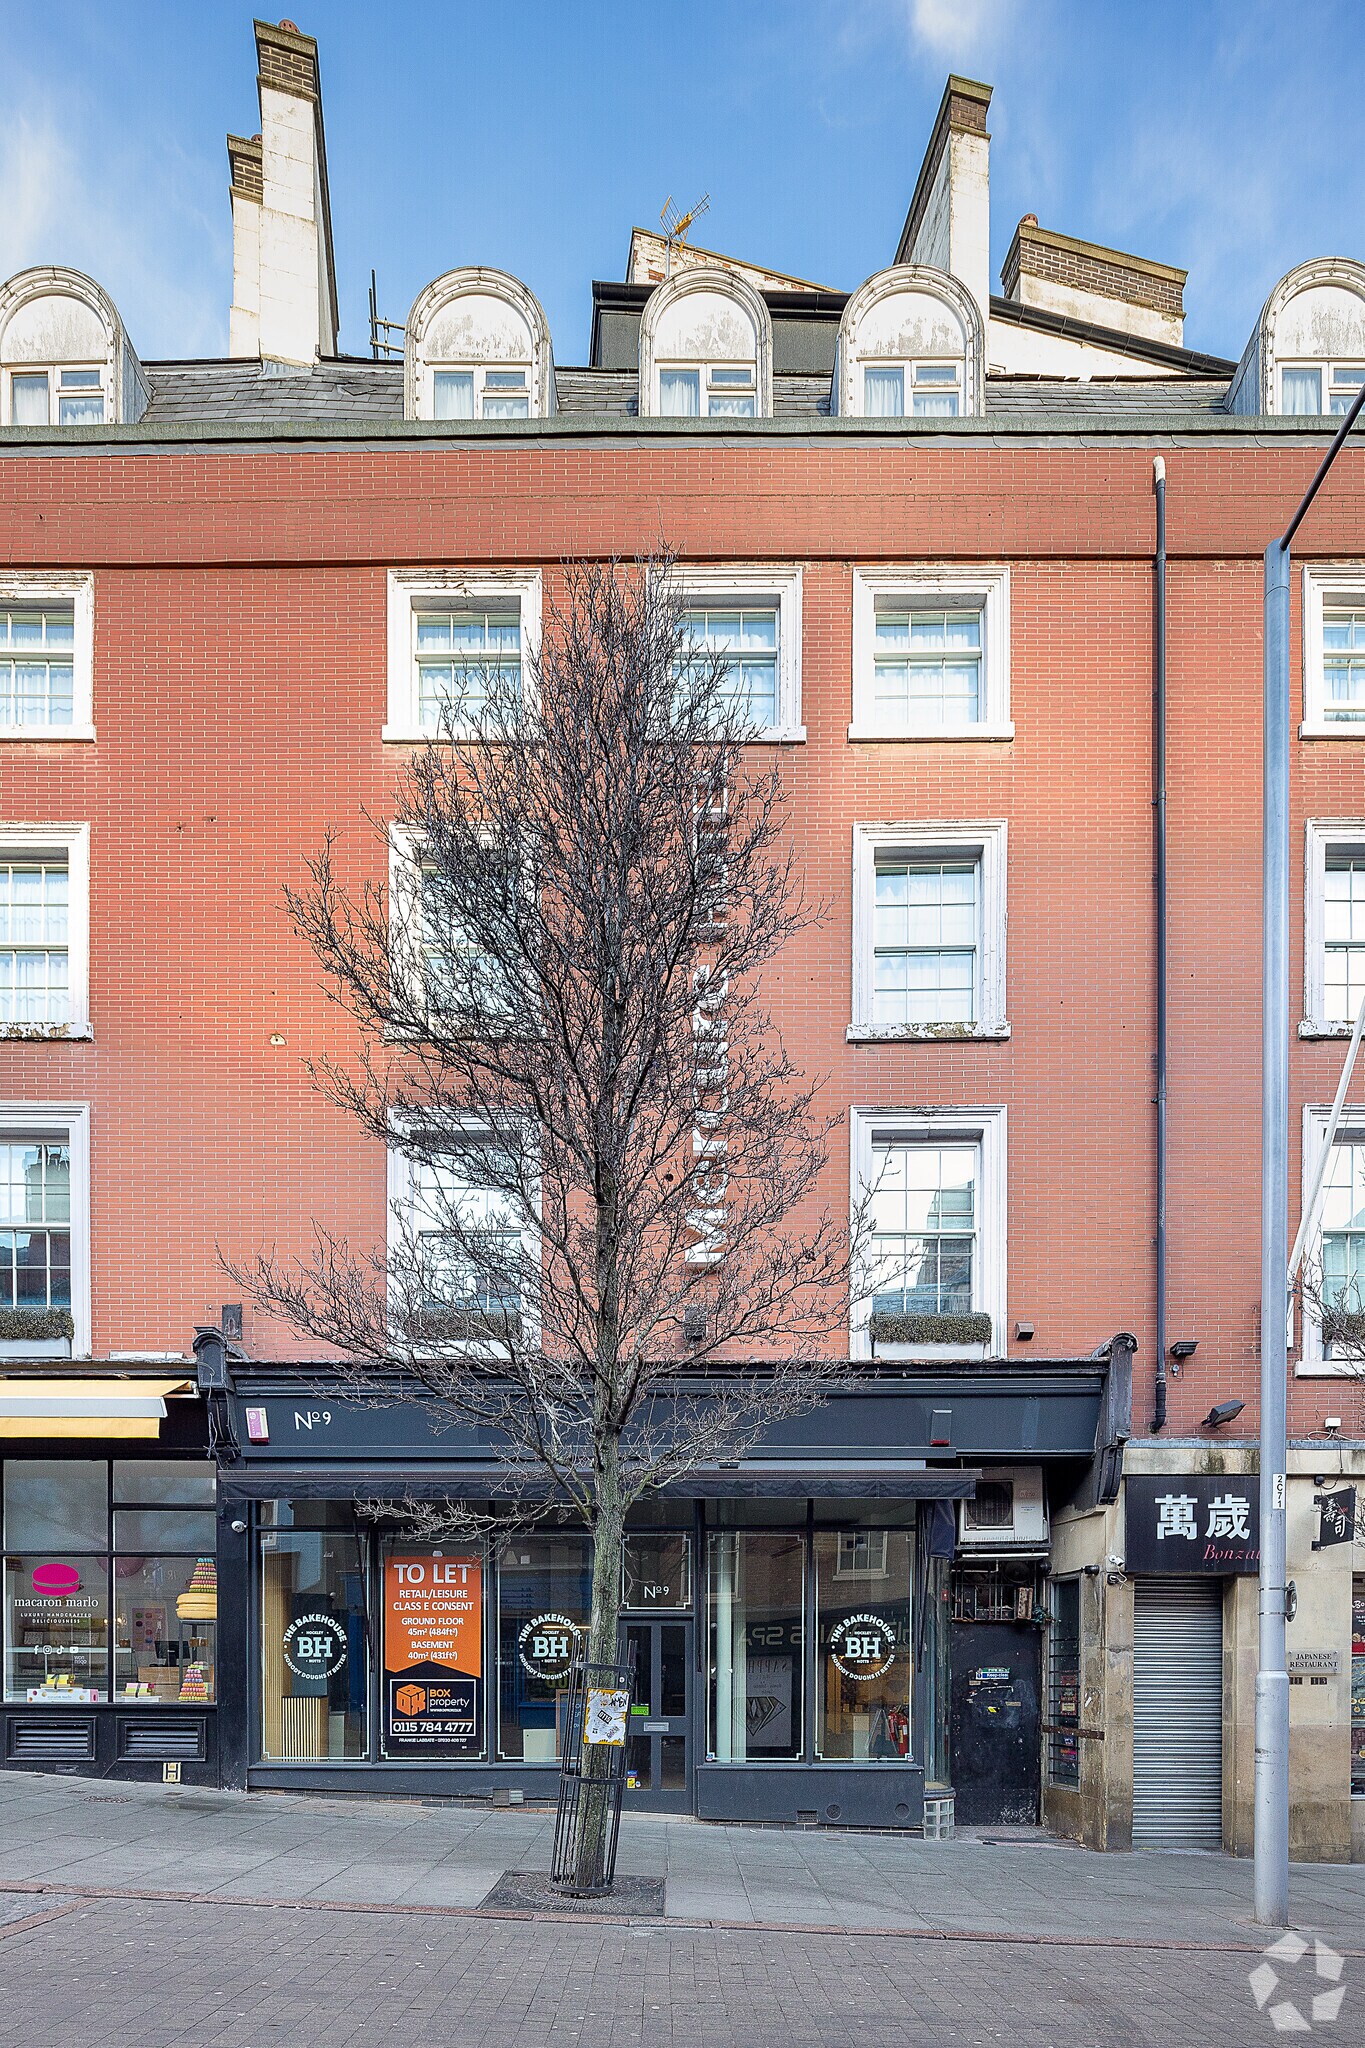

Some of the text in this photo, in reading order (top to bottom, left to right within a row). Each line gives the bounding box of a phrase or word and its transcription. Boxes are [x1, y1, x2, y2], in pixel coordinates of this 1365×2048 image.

[1154, 1493, 1251, 1540] 萬歲
[393, 1563, 472, 1584] TO LET
[14, 1596, 99, 1607] macaron marlo
[399, 1588, 468, 1599] RETAIL/LEISURE
[393, 1602, 474, 1611] CLASS E CONSENT
[283, 1614, 347, 1642] THE BAKEHOUSE
[401, 1617, 464, 1625] GROUND FLOOR
[831, 1624, 845, 1642] THE
[843, 1613, 896, 1642] BAKEHOUSE
[408, 1628, 427, 1636] 45m²
[518, 1623, 533, 1642] THE
[297, 1637, 333, 1657] BH
[411, 1641, 454, 1649] BASEMENT
[532, 1636, 569, 1657] BH
[845, 1636, 881, 1658] BH
[284, 1653, 302, 1675] NOBODY
[331, 1653, 347, 1673] BETTER
[408, 1652, 428, 1660] 40m²
[831, 1653, 850, 1676] NOBODY
[879, 1653, 896, 1673] BETTER
[519, 1653, 538, 1675] NOBODY
[537, 1672, 563, 1680] DOUGHS
[562, 1669, 569, 1677] IT
[429, 1689, 451, 1697] BOX
[429, 1697, 470, 1707] property
[393, 1721, 473, 1732] 0115 784 4777
